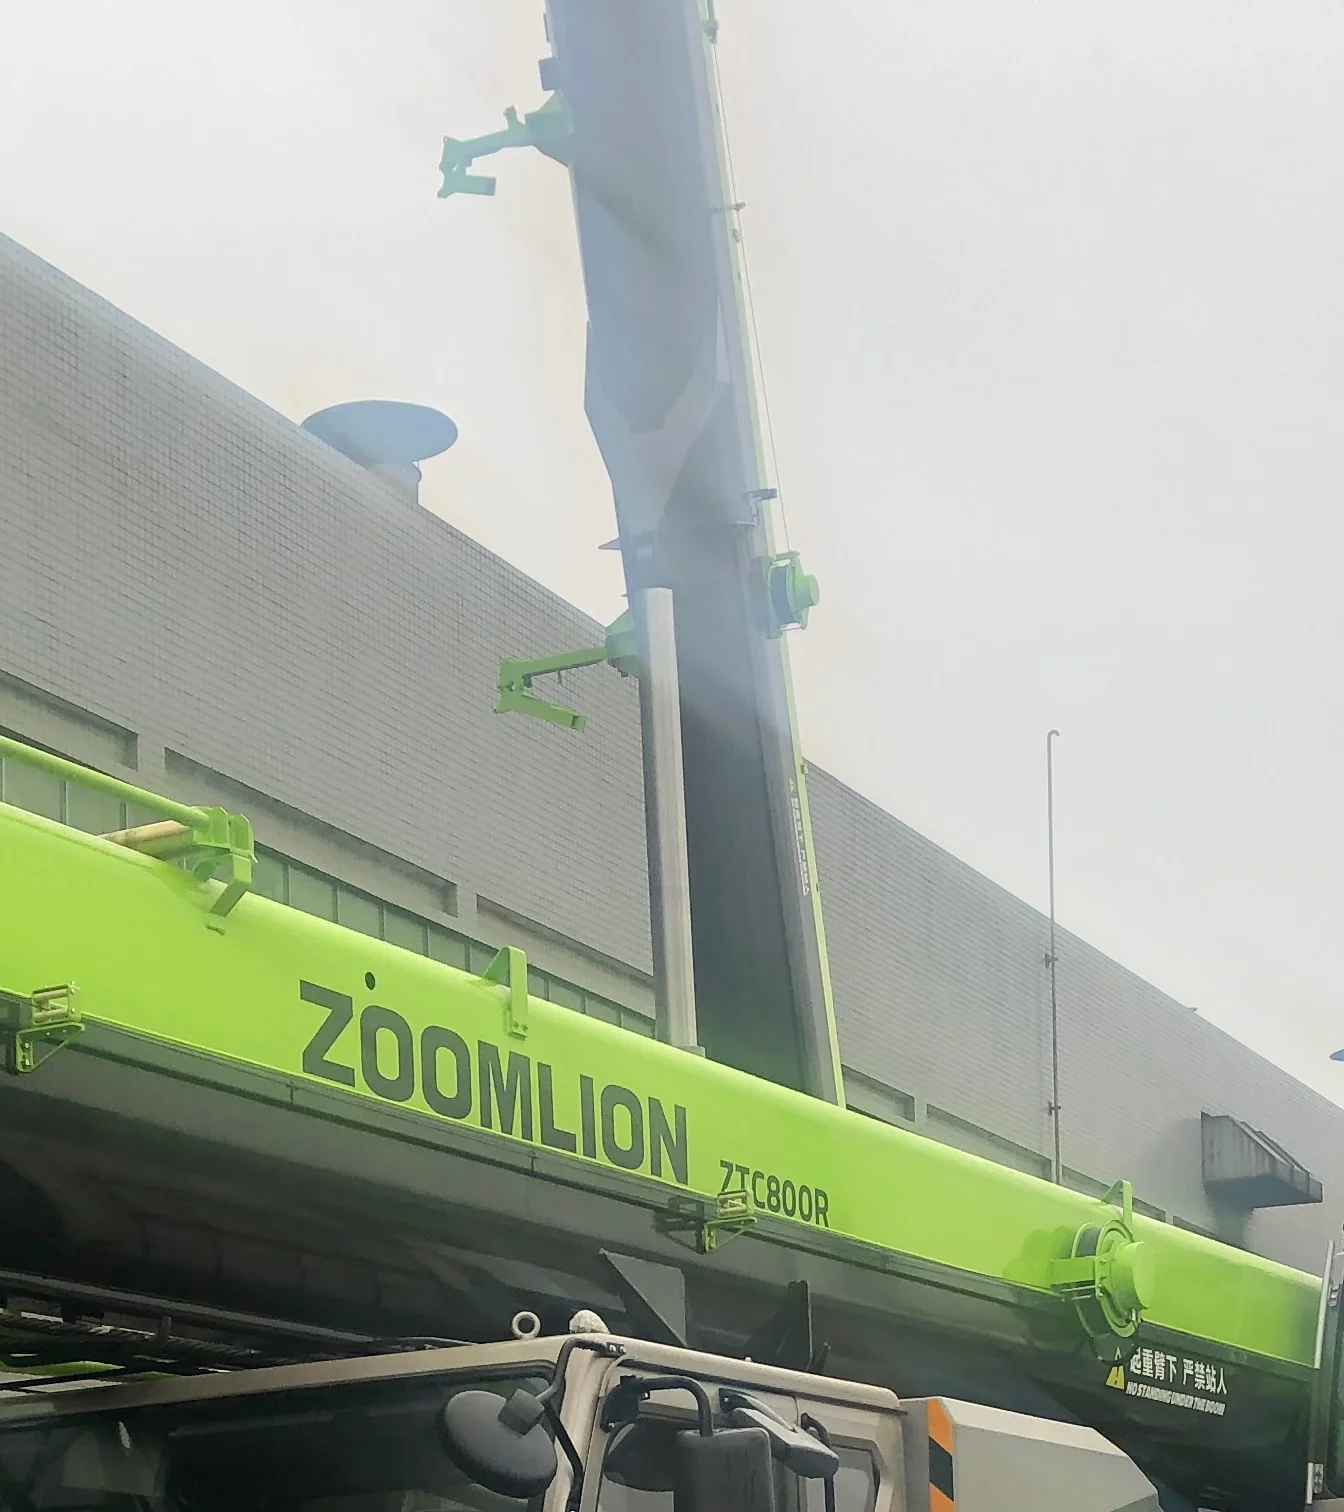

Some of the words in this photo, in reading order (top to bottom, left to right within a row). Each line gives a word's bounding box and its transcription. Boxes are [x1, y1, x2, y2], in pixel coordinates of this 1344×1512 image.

[299, 979, 689, 1184] ZOOMLION
[720, 1159, 829, 1228] ZTC800R
[1126, 1381, 1137, 1396] NO
[1137, 1383, 1173, 1403] STANDING
[1171, 1391, 1194, 1409] UNDER
[1182, 1358, 1228, 1395] 严禁站人
